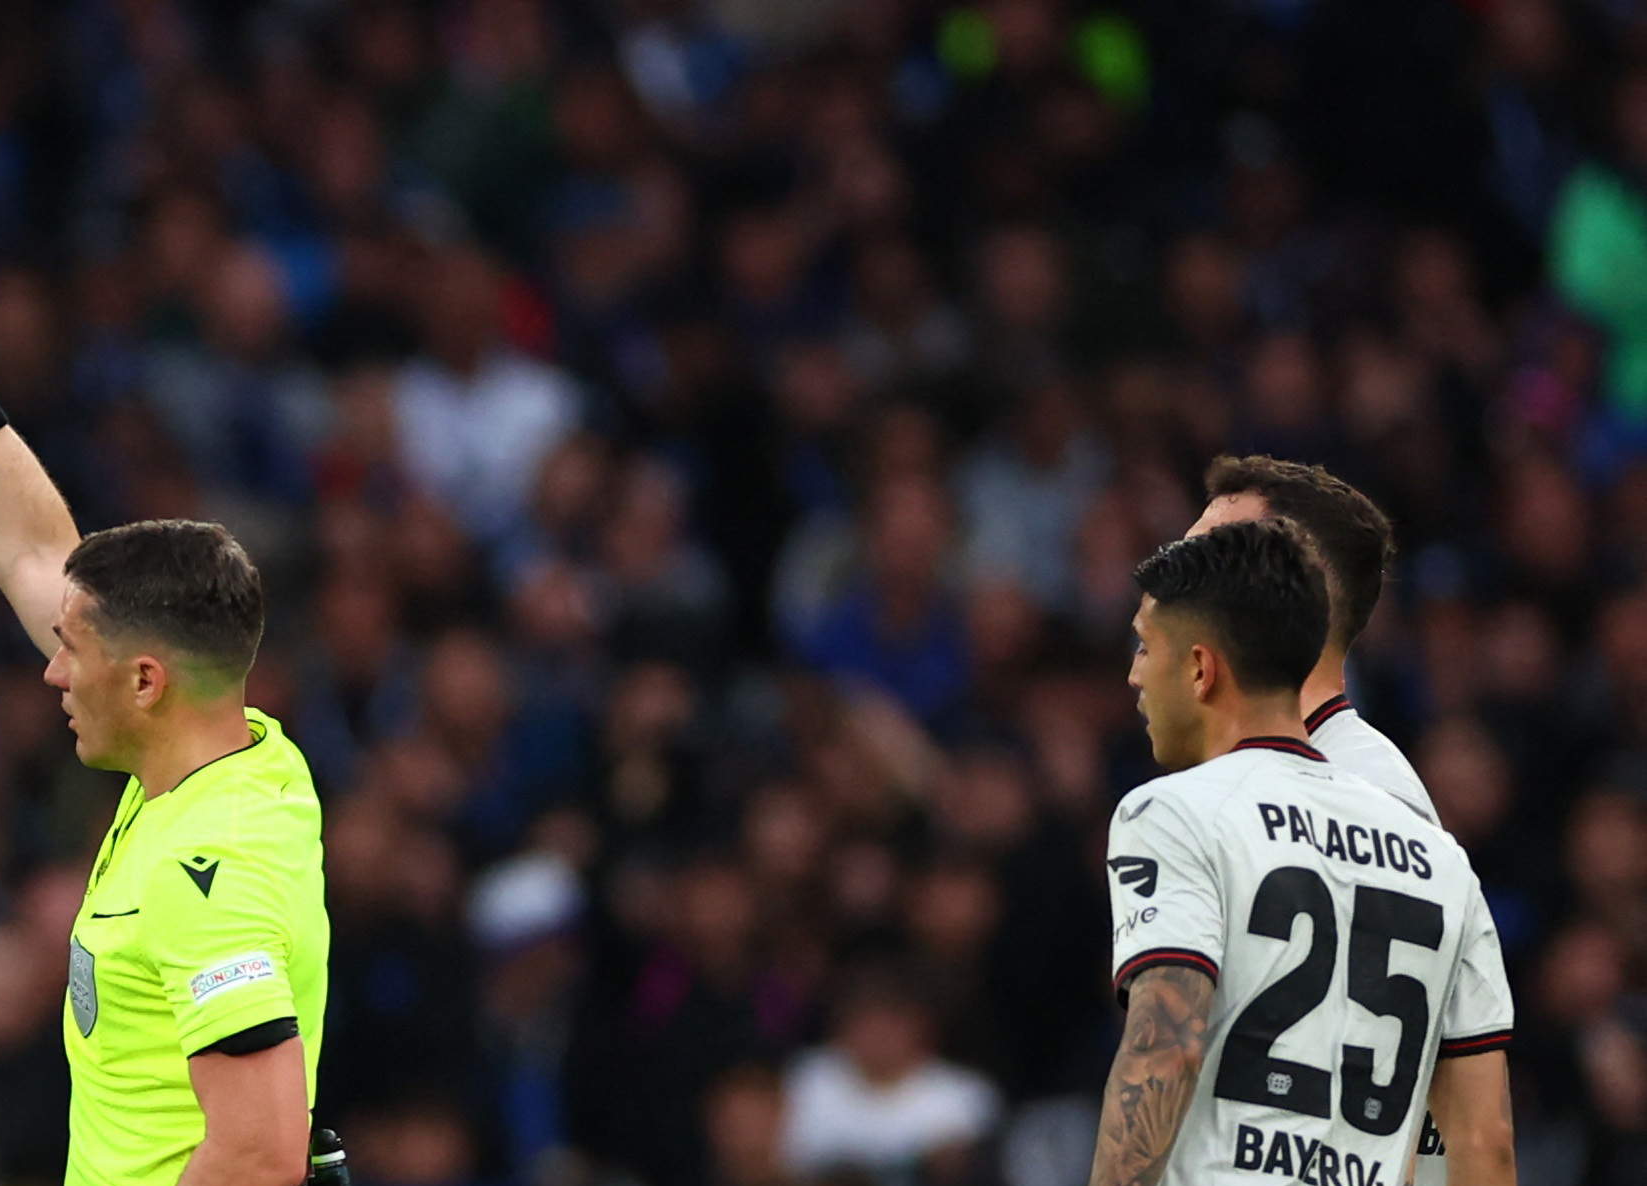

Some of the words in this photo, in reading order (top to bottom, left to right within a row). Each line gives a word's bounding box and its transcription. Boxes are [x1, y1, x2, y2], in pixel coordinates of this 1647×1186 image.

[1257, 803, 1432, 881] PALACIOS
[192, 960, 271, 997] FOUNDATION
[1213, 866, 1444, 1137] 25
